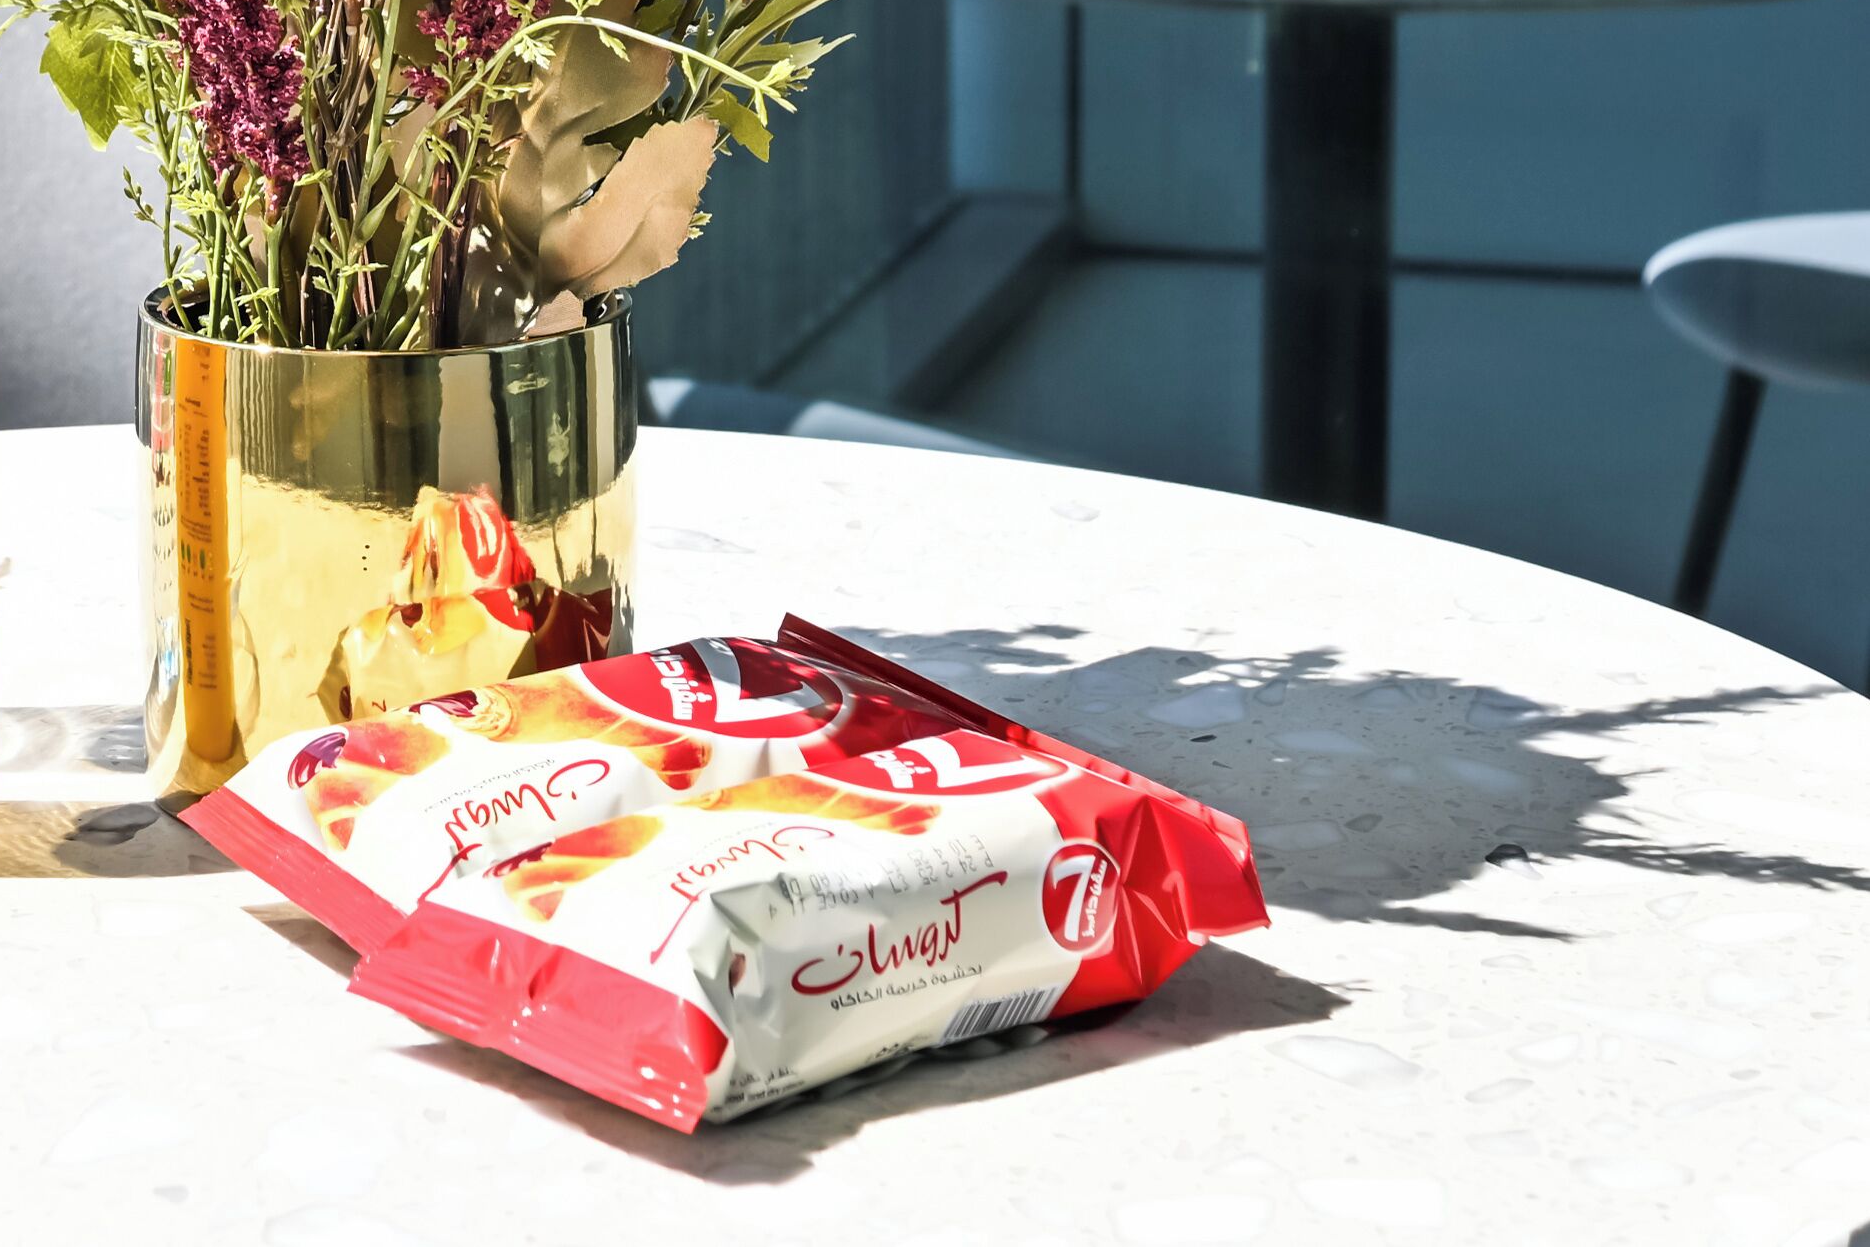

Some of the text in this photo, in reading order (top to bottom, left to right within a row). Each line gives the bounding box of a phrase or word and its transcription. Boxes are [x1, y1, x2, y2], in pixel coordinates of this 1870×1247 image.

[1052, 854, 1096, 943] 7
[830, 986, 883, 1012] الكاكاو
[885, 979, 928, 998] كريمة
